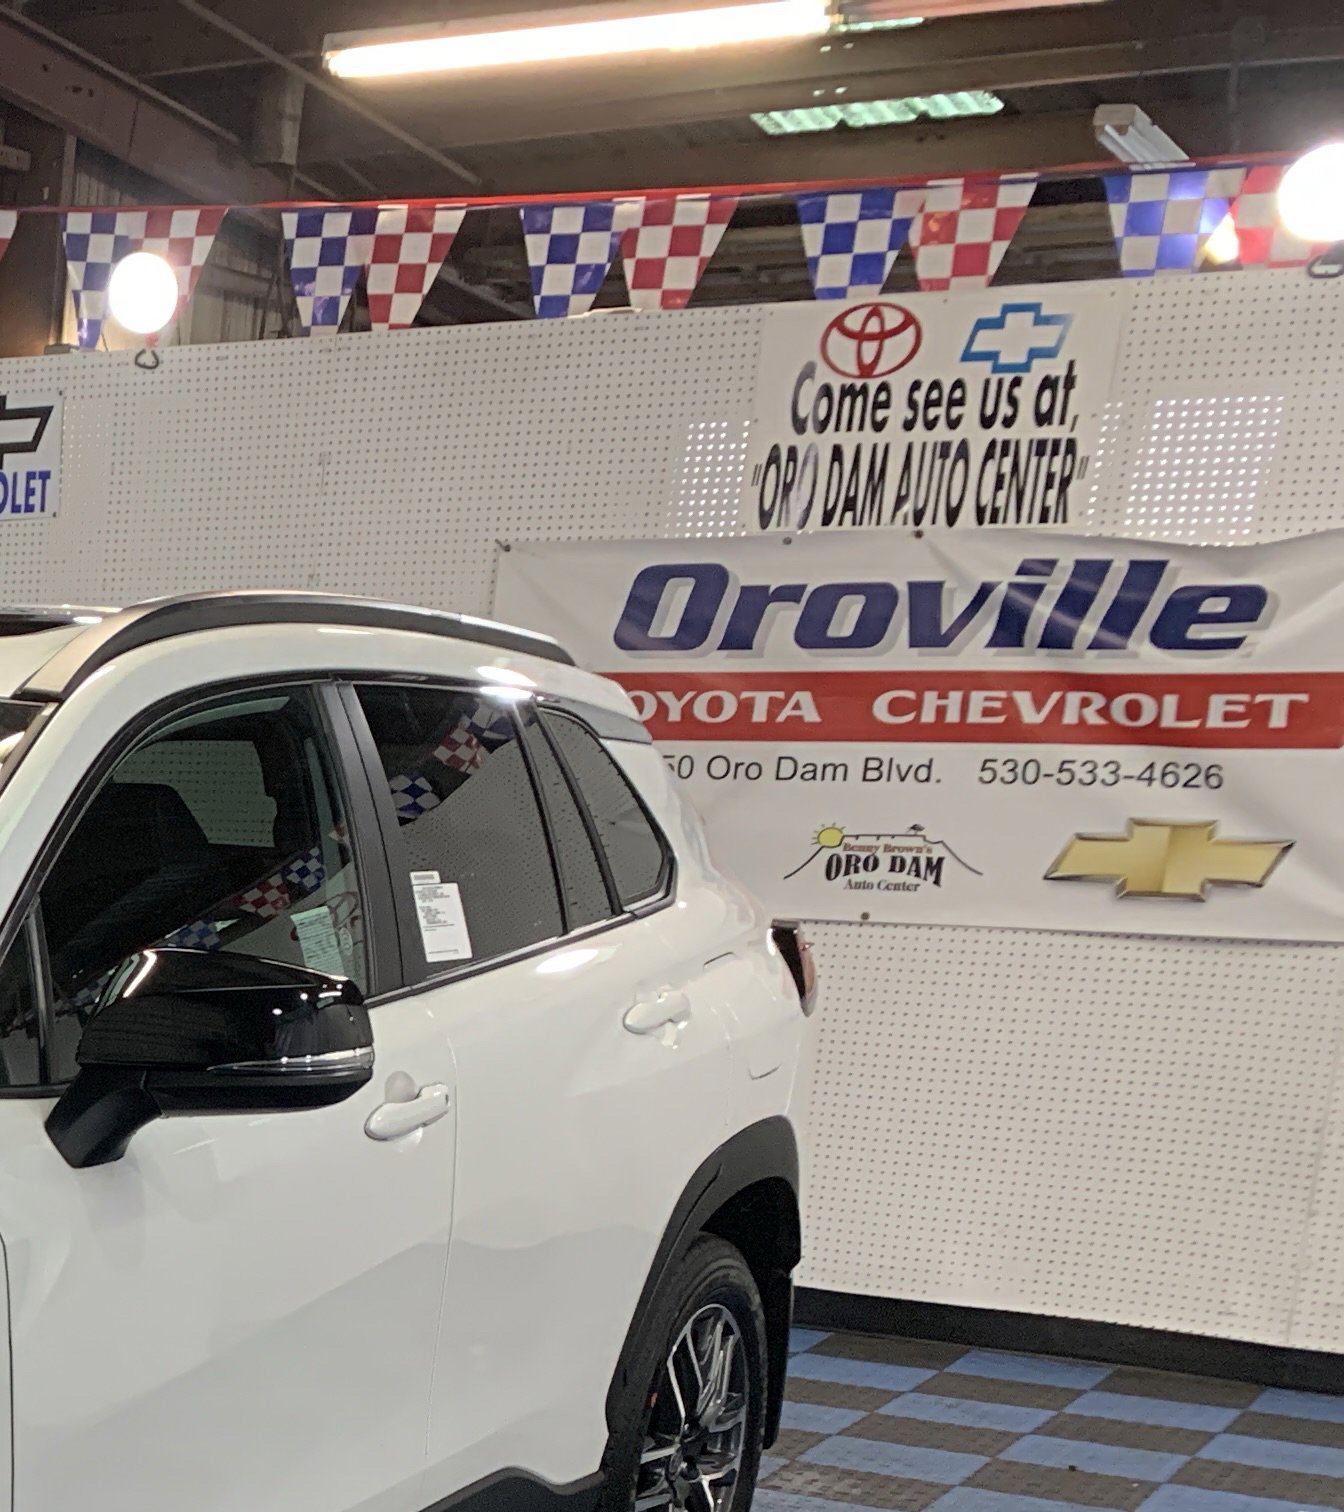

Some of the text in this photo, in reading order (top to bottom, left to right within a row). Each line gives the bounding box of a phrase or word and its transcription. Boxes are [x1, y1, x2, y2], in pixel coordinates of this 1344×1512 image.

[790, 359, 1079, 436] Come see us at,
[751, 437, 1090, 530] "ORO DAM AUTO CENTER"
[611, 556, 1272, 654] Oroville
[625, 687, 1309, 731] OYOTA CHEVROLET
[706, 755, 763, 782] Oro
[775, 756, 849, 783] Dam
[861, 756, 942, 784] Blvd.
[977, 757, 1224, 791] 530-533-4626
[825, 853, 945, 888] ORO DAM
[843, 879, 921, 892] Auto Center
